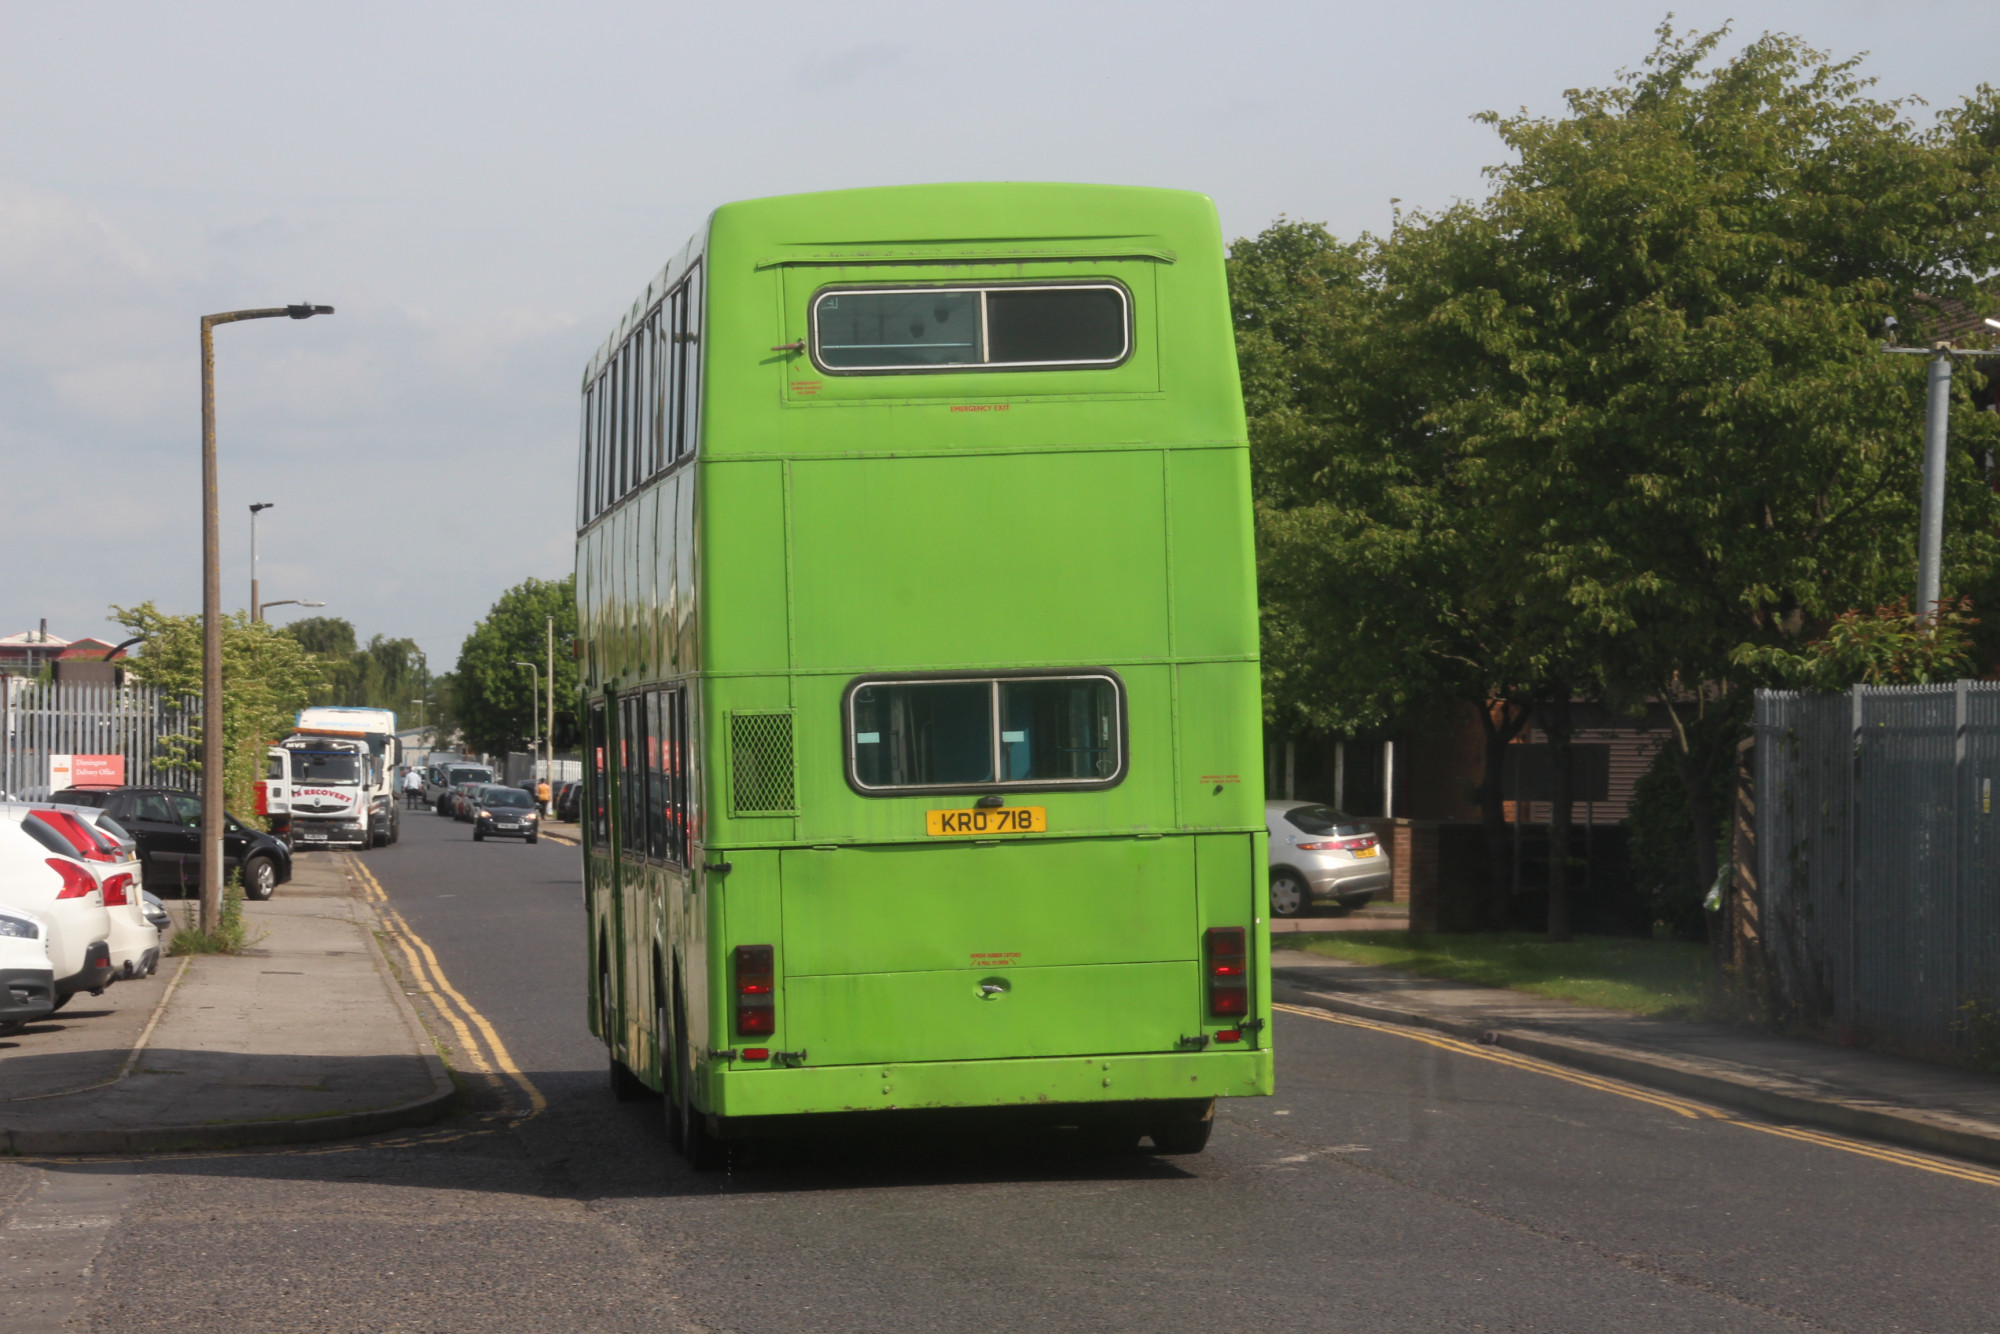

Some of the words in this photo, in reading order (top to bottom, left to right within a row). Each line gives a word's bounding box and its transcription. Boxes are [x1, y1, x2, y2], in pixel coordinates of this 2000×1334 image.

[994, 404, 1010, 412] EXIT
[75, 769, 98, 777] Delivery
[99, 768, 116, 776] Office
[303, 789, 352, 803] RECOVERY
[941, 811, 988, 832] KRO
[996, 810, 1032, 830] 718
